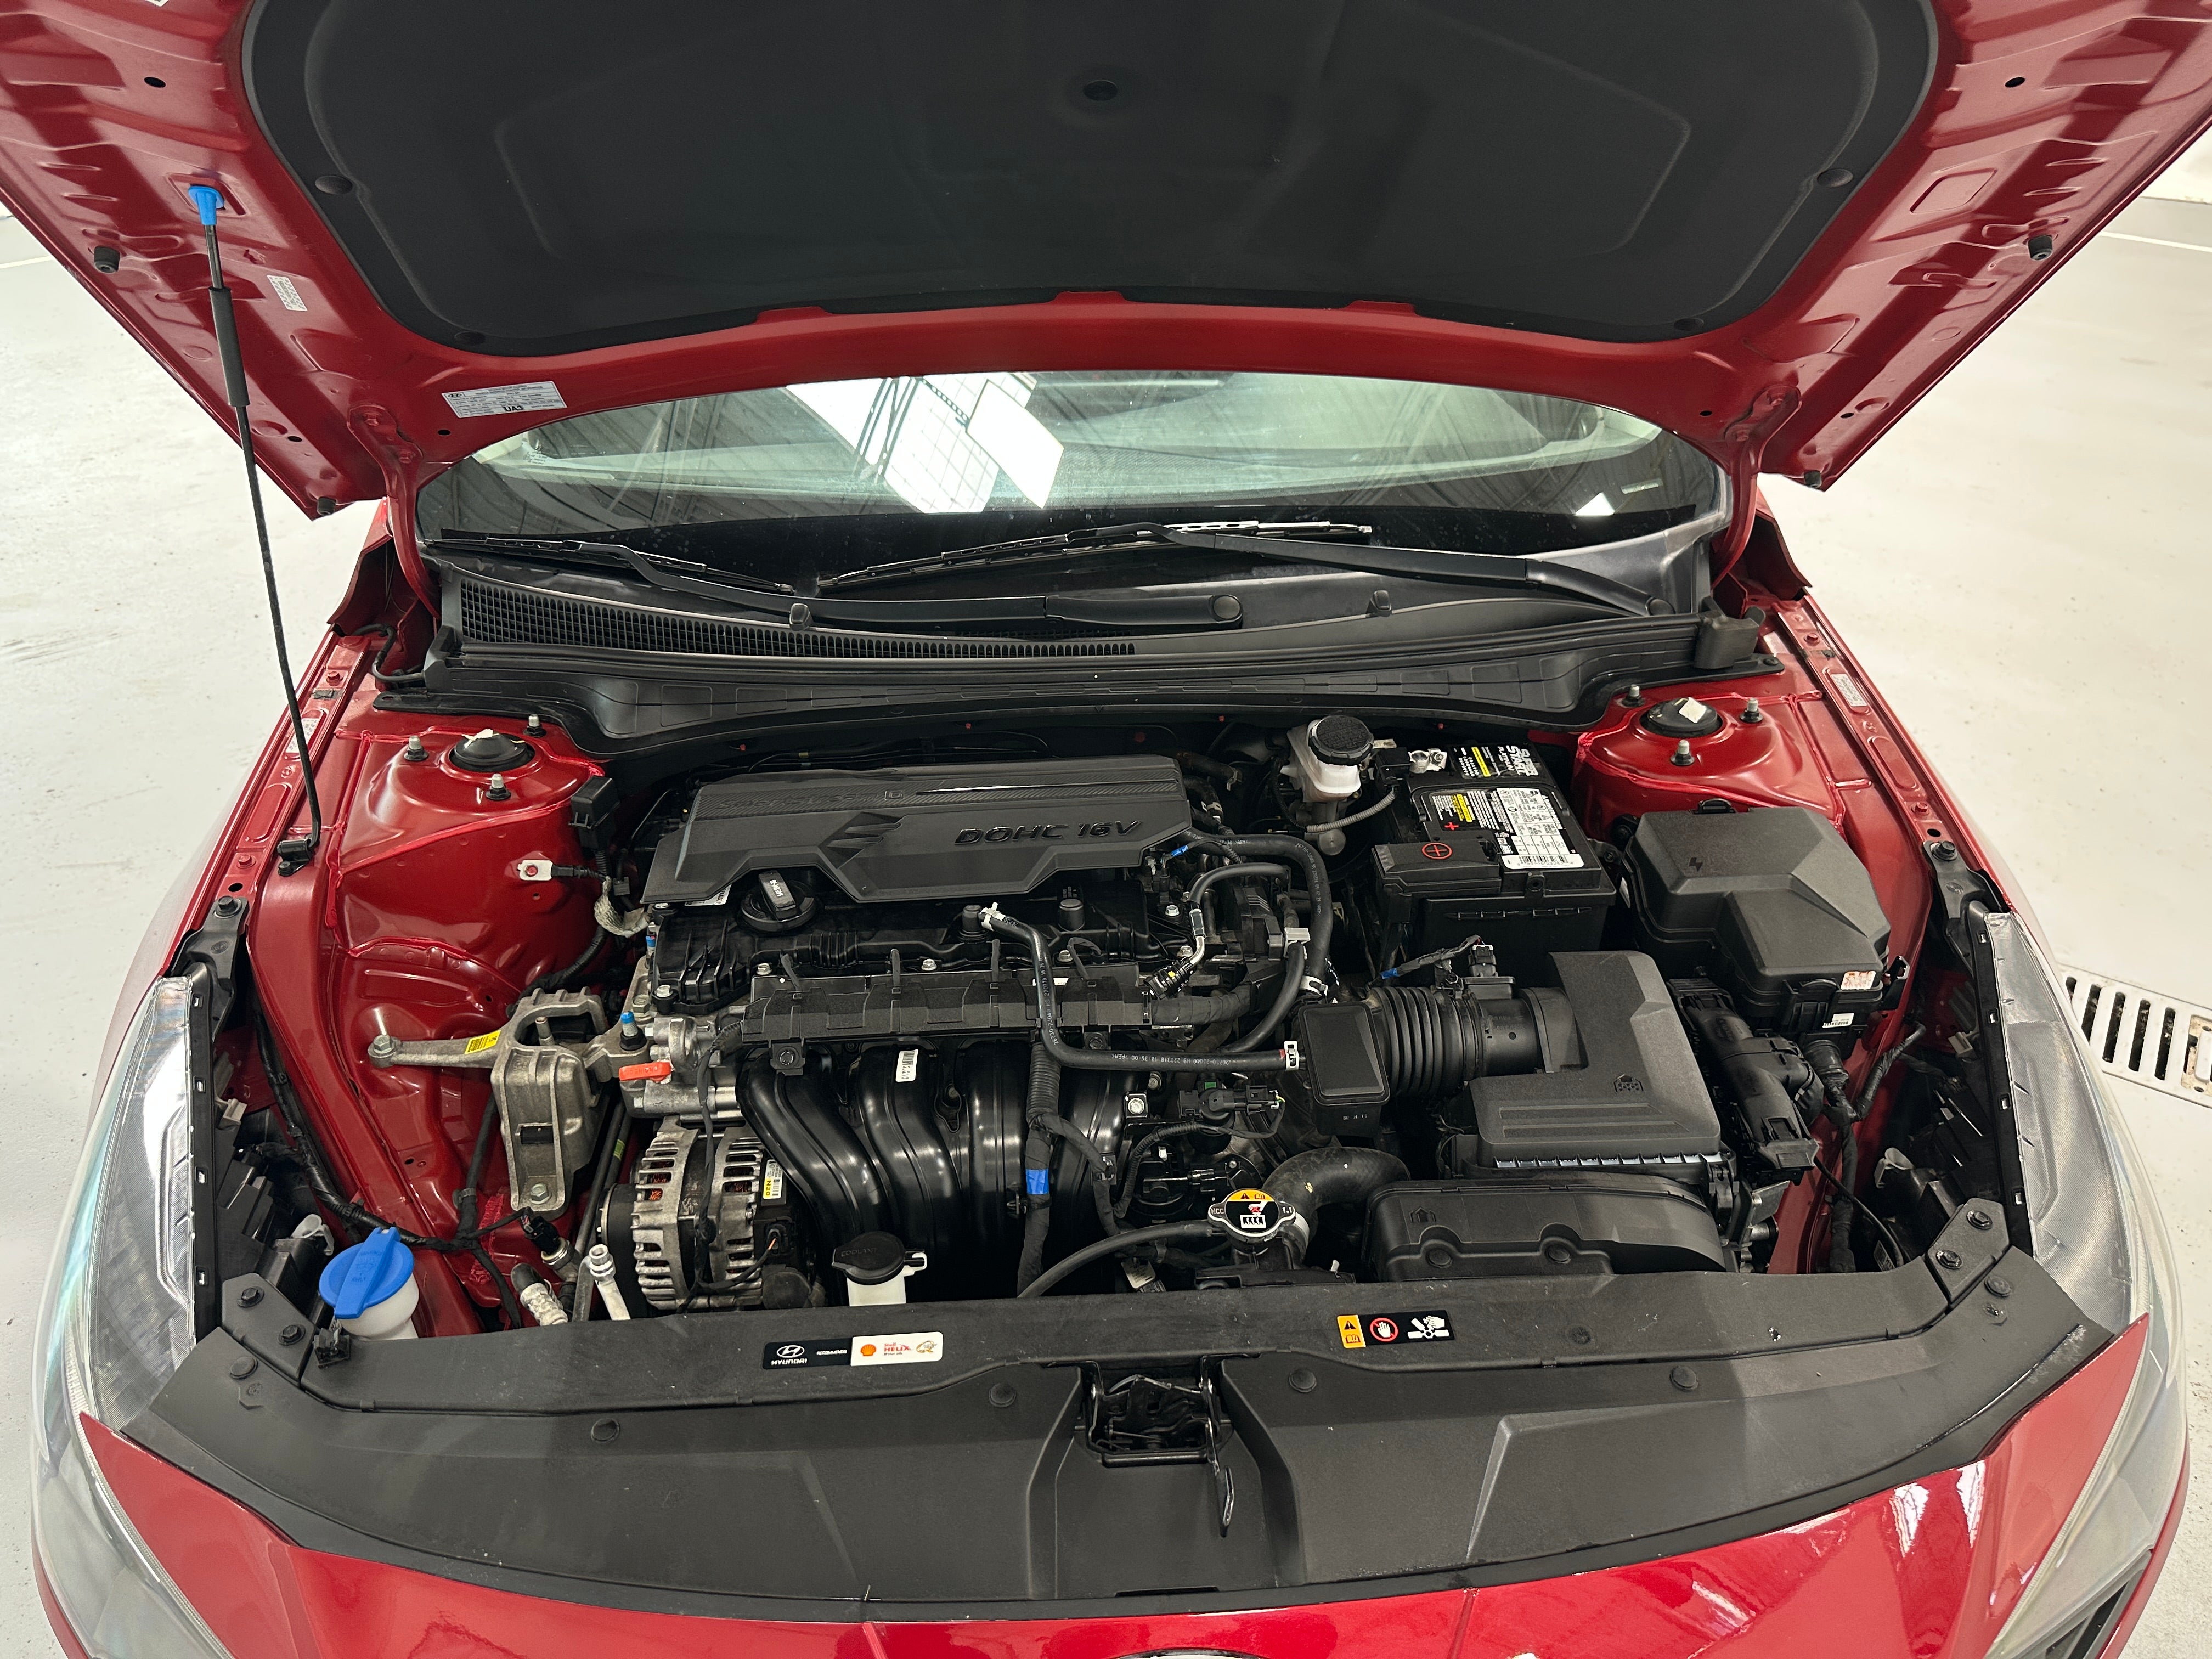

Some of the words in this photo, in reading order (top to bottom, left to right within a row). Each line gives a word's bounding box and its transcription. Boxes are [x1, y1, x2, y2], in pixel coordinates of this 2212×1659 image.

[1498, 746, 1515, 771] PLATINUM
[1505, 745, 1531, 776] START
[1518, 748, 1539, 776] SUPER
[955, 824, 1070, 845] DOHC
[1077, 820, 1142, 837] 16V
[841, 1248, 877, 1257] COOLANT
